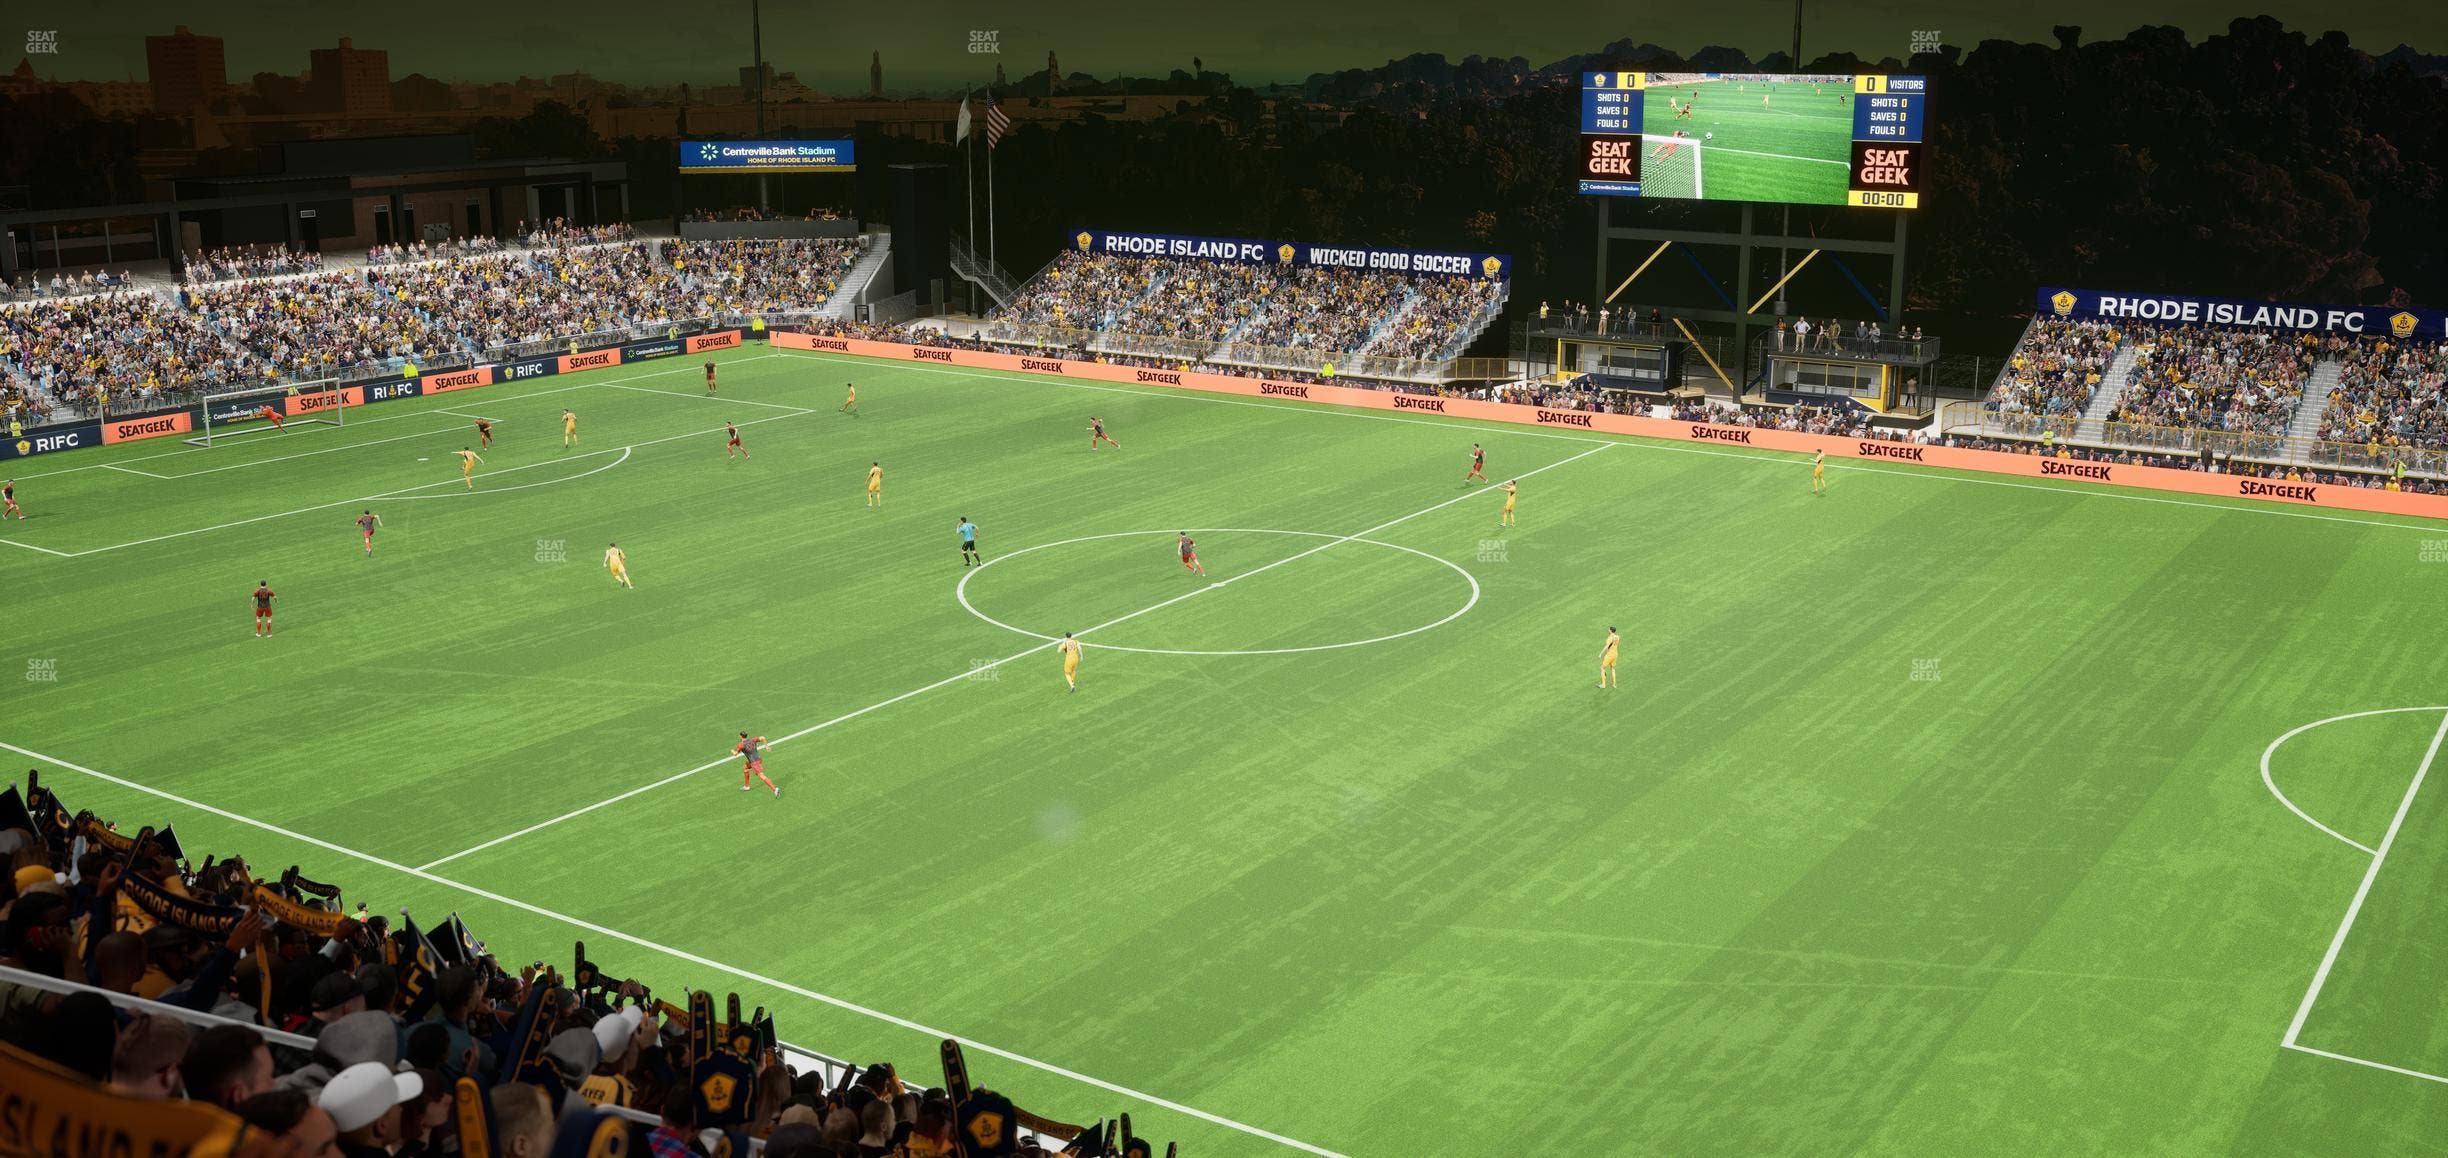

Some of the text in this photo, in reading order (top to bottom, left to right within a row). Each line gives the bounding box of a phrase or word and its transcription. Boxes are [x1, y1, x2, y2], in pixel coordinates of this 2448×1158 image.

[1627, 74, 1635, 88] 0
[1866, 77, 1876, 91] 0
[1889, 80, 1924, 90] VISITORS
[1597, 94, 1629, 102] SHOTS 0
[1871, 98, 1907, 107] SHOTS 0
[1597, 106, 1628, 115] SAVES 0
[1870, 112, 1906, 121] SAVES 0
[1597, 119, 1628, 128] FOULS 0
[1869, 126, 1905, 135] FOULS 0
[723, 146, 836, 156] Centreville Bank Stadium
[1592, 141, 1631, 157] SEAT
[1864, 149, 1909, 166] SEAT
[1589, 158, 1632, 175] GEEK
[1860, 167, 1909, 185] GEEK
[1862, 192, 1904, 206] 00:00
[1105, 236, 1264, 261] RHODE ISLAND FC
[1310, 248, 1471, 275] WICKED GOOD SOCCER
[2099, 296, 2364, 332] RHODE ISLAND FC
[697, 335, 732, 350] SEATGEEK
[810, 338, 849, 352] SEATGEEK
[569, 352, 610, 369] SEATGEEK
[913, 348, 952, 362] SEATGEEK
[516, 363, 543, 378] RIFC
[1021, 358, 1063, 374] SEATGEEK
[435, 372, 480, 390] SEATGEEK
[1137, 370, 1181, 386] SEATGEEK
[1261, 382, 1308, 399] SEATGEEK
[300, 392, 350, 411] SEATGEK
[1394, 395, 1445, 413] SEATGEEK
[1537, 409, 1594, 428] SEATGEEK
[118, 418, 175, 439] SEATGEEK
[1691, 425, 1751, 444] SEATGEEK
[36, 433, 79, 453] RIFC
[1858, 442, 1923, 462] SEATGEEK
[2041, 460, 2111, 481] SEATGEEK
[2239, 480, 2317, 502] SEATGEEK
[172, 904, 217, 933] ISLAND
